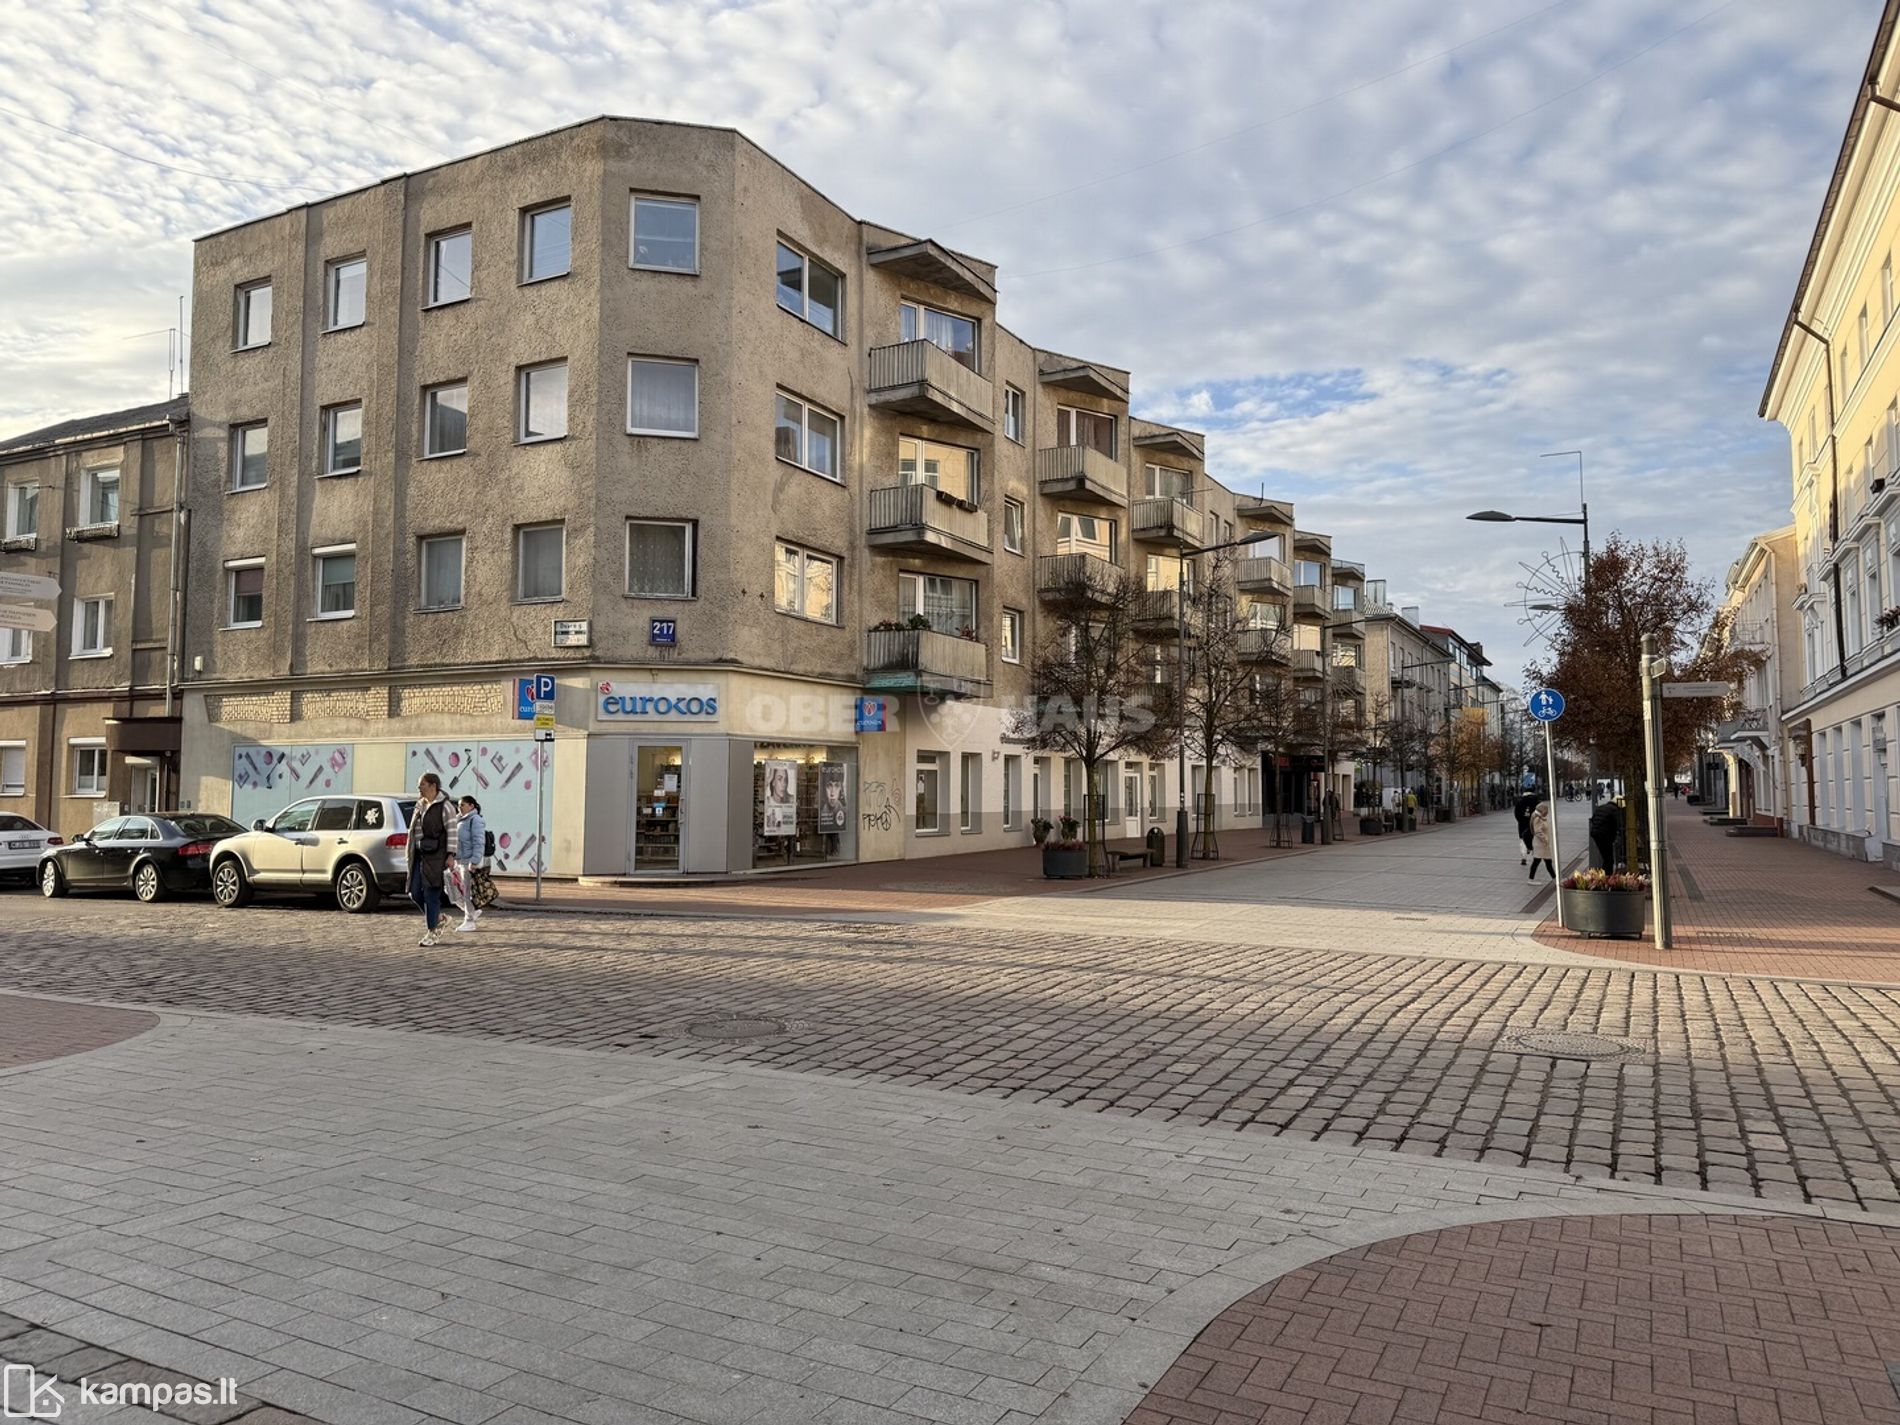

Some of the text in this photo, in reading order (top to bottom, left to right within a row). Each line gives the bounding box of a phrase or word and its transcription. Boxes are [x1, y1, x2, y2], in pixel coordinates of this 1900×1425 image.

[653, 622, 675, 635] 217
[540, 677, 552, 698] P
[602, 696, 718, 715] eurokos
